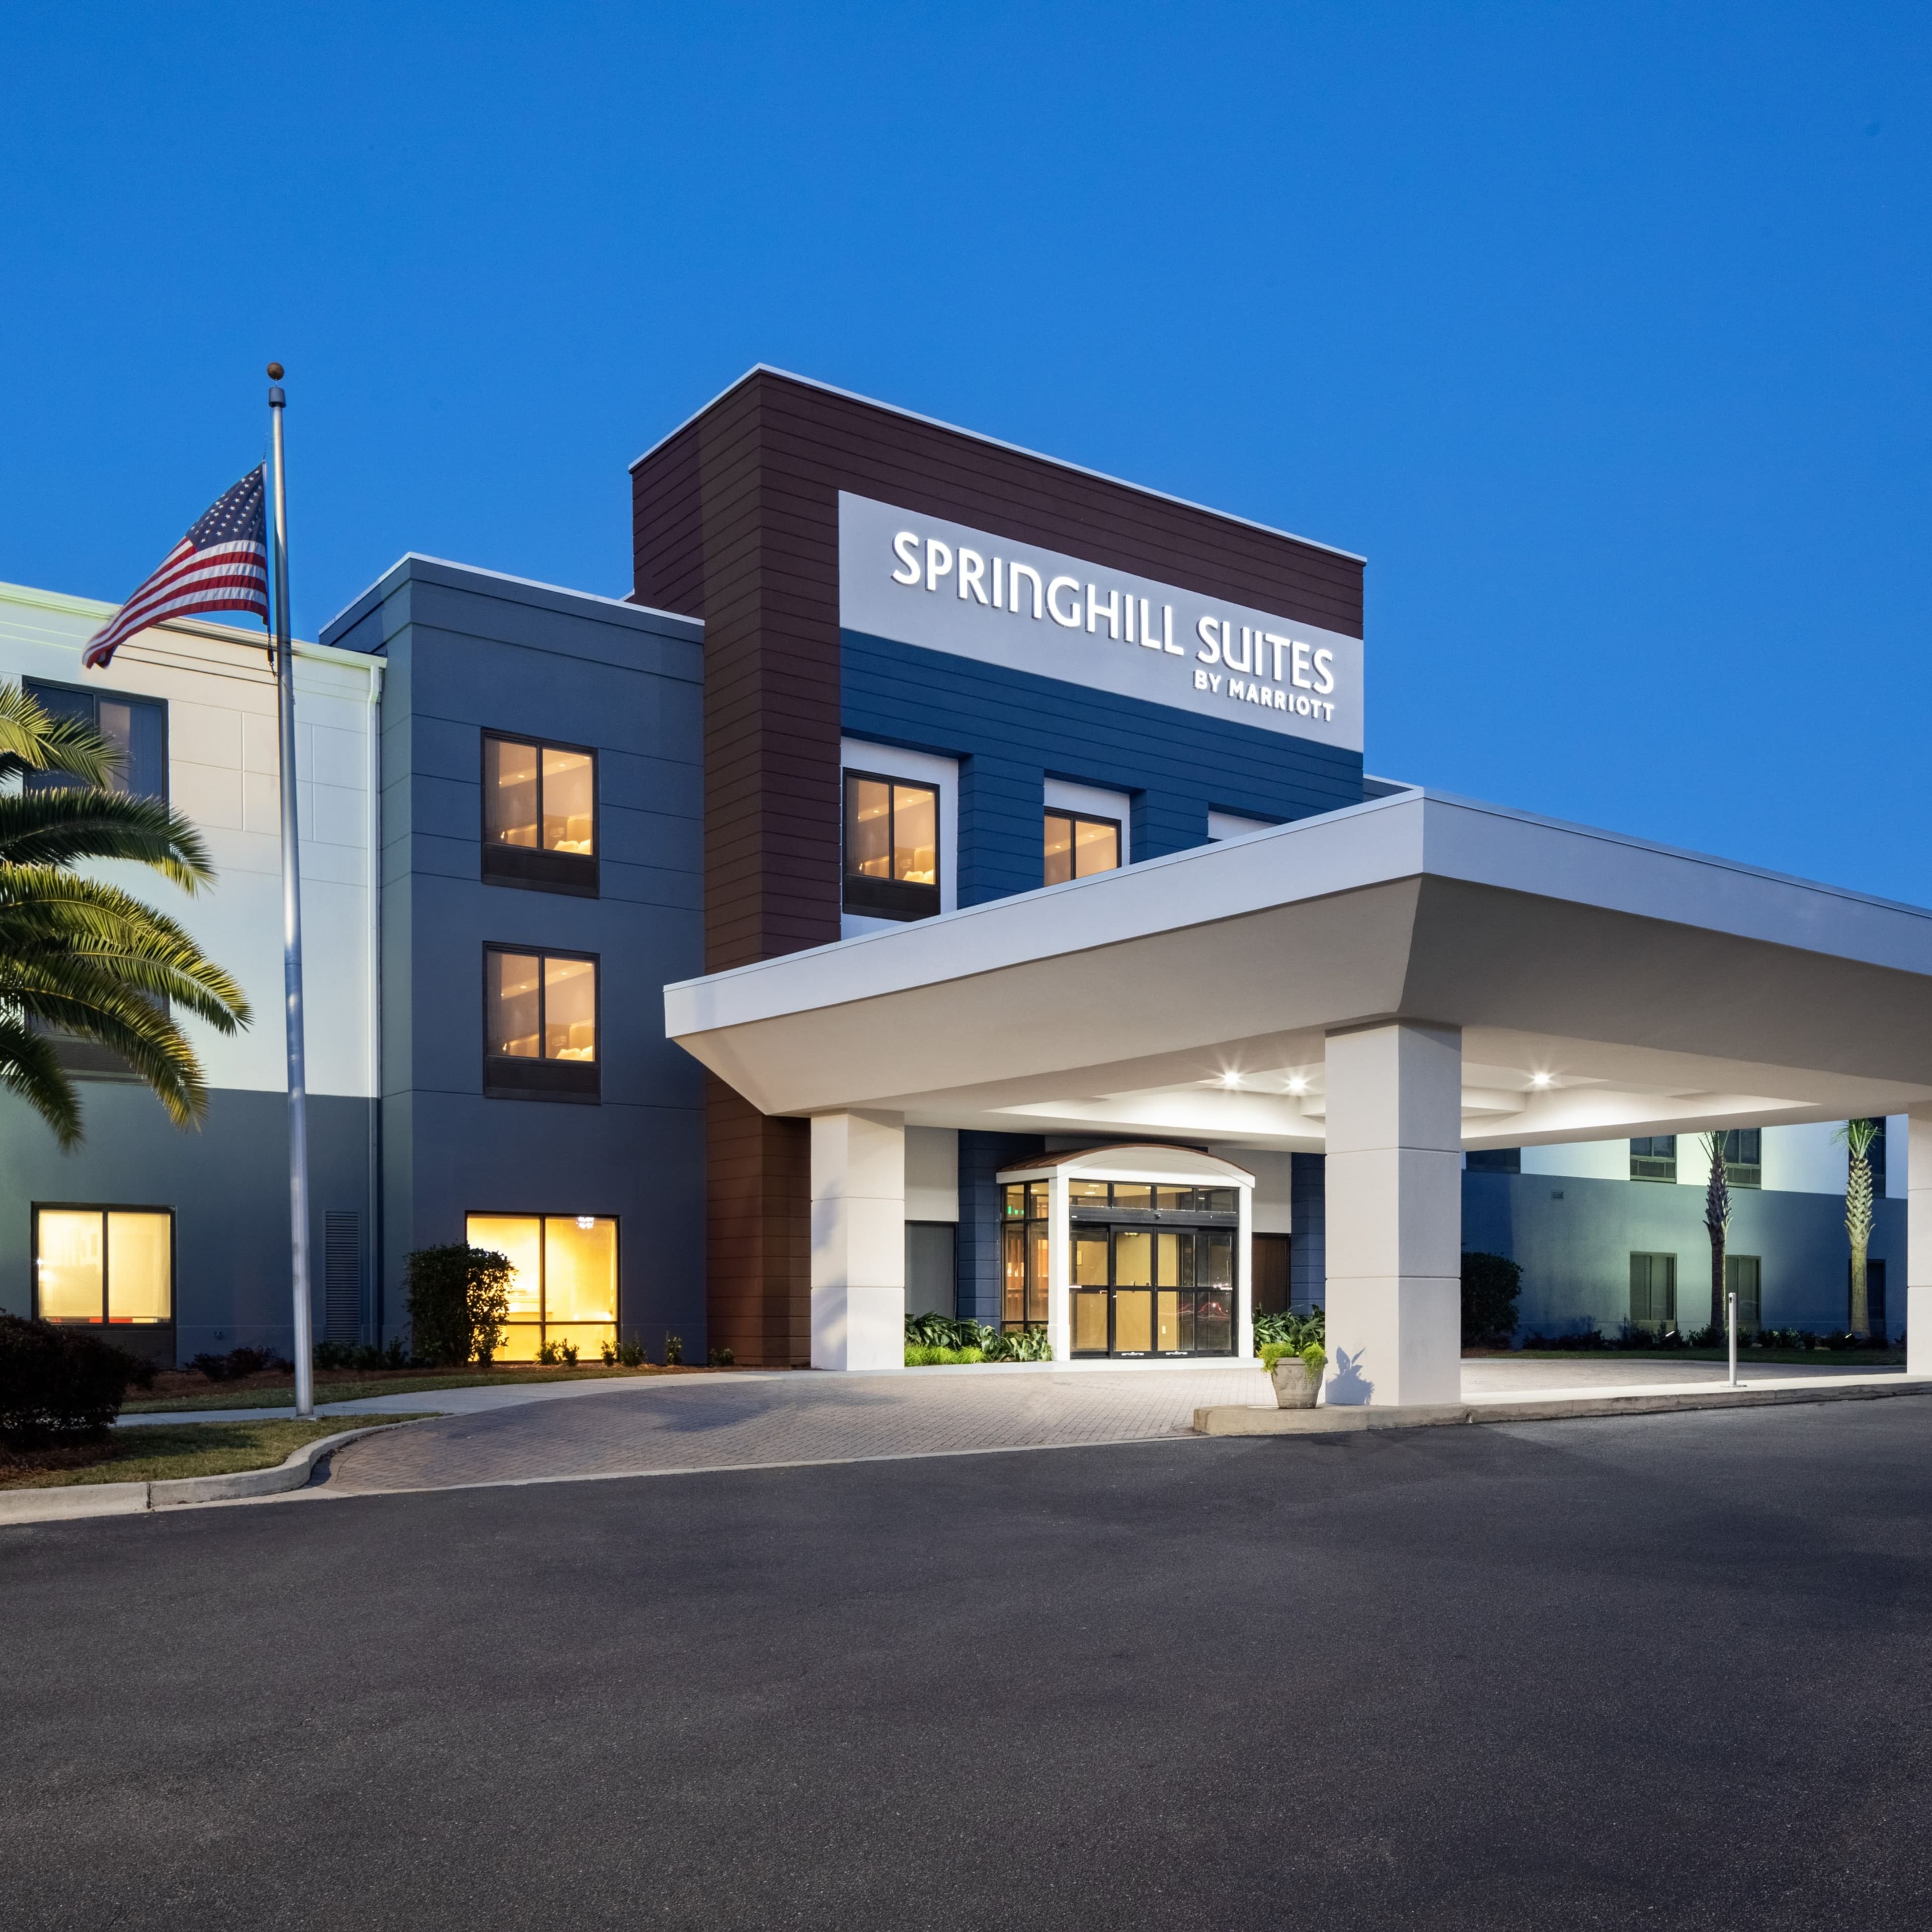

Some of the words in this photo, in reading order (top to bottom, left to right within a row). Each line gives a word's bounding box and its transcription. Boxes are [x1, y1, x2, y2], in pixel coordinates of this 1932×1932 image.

[1196, 616, 1334, 694] SUITES
[1193, 669, 1222, 693] BY
[1228, 678, 1334, 721] MARRIOTT
